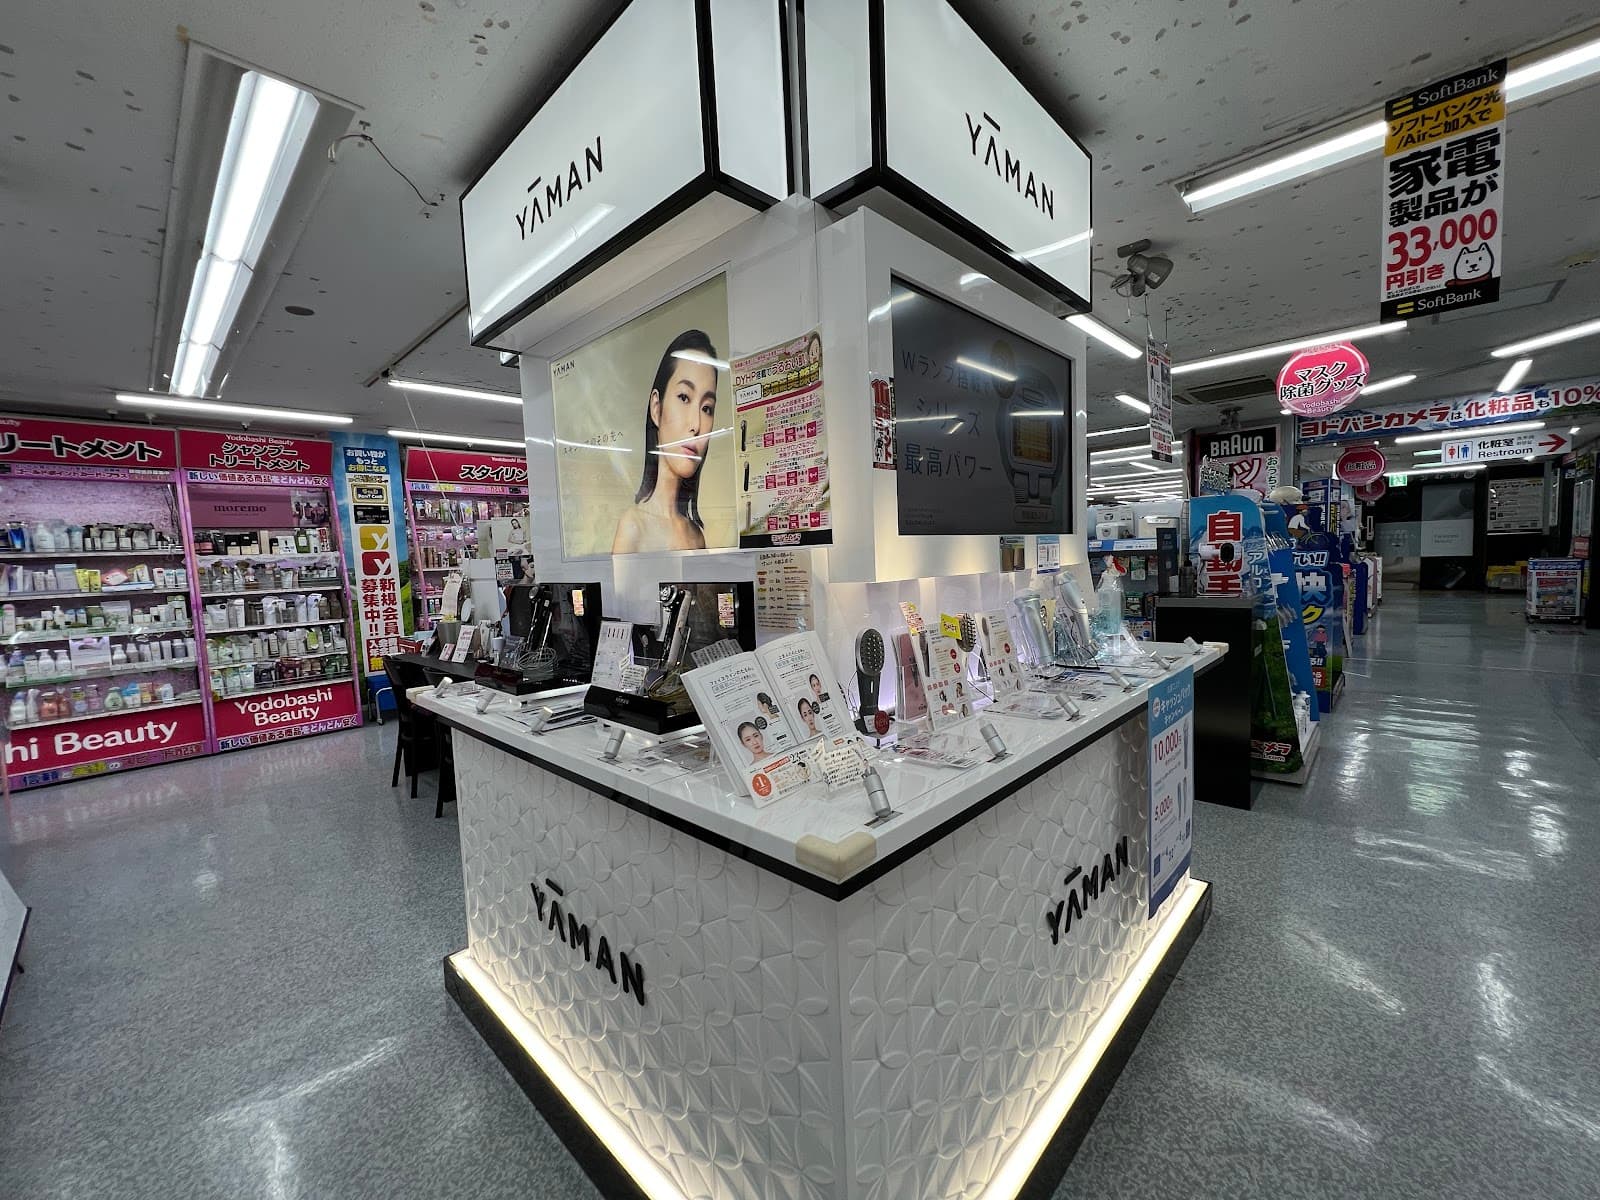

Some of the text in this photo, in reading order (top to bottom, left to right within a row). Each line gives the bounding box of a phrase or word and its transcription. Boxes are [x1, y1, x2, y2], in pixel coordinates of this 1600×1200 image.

[1418, 67, 1499, 106] SoftBank
[1391, 90, 1501, 137] ソフトバンク光
[1397, 108, 1492, 149] /Airご加入で
[1389, 127, 1501, 199] 家電
[1389, 172, 1499, 227] 製品が
[1386, 208, 1498, 272] 33,000
[1386, 263, 1445, 291] 円引き
[1417, 288, 1481, 311] SoftBank
[1295, 361, 1346, 382] マスク
[1280, 373, 1365, 400] 除菌グッズ
[1302, 398, 1341, 409] Yodobashi
[222, 442, 298, 457] シャンプー
[226, 434, 295, 447] Yodobashi Beauty
[1210, 434, 1264, 457] BRAUN
[1478, 435, 1515, 449] 化粧室
[1478, 446, 1534, 459] Restroom
[209, 454, 310, 472] トリートメント
[356, 457, 379, 465] もっと
[1267, 456, 1279, 489] おうち
[379, 578, 399, 636] 新規会員
[234, 688, 333, 715] Yodobashi
[254, 706, 320, 727] Beauty
[54, 721, 177, 756] Beauty
